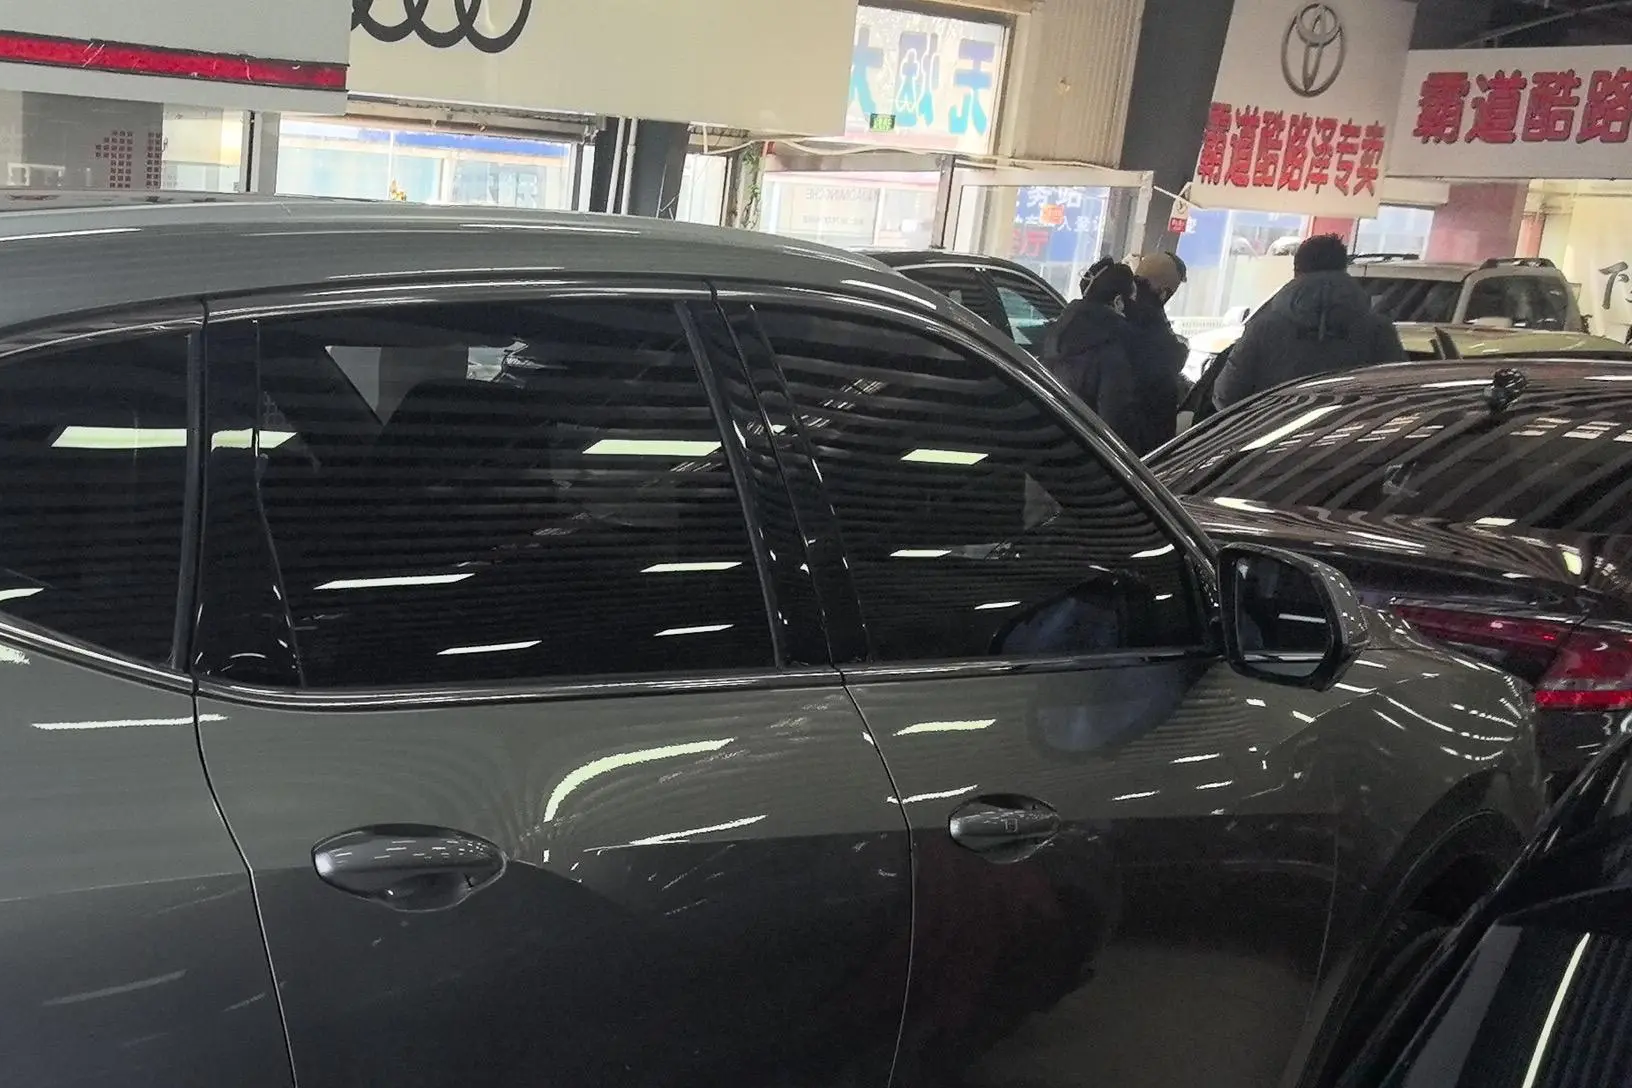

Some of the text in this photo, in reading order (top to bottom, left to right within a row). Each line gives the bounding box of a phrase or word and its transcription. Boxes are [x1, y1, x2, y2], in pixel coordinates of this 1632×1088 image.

[1413, 67, 1632, 145] 霸道酷路
[1197, 102, 1386, 197] 霸道酷路泽专卖
